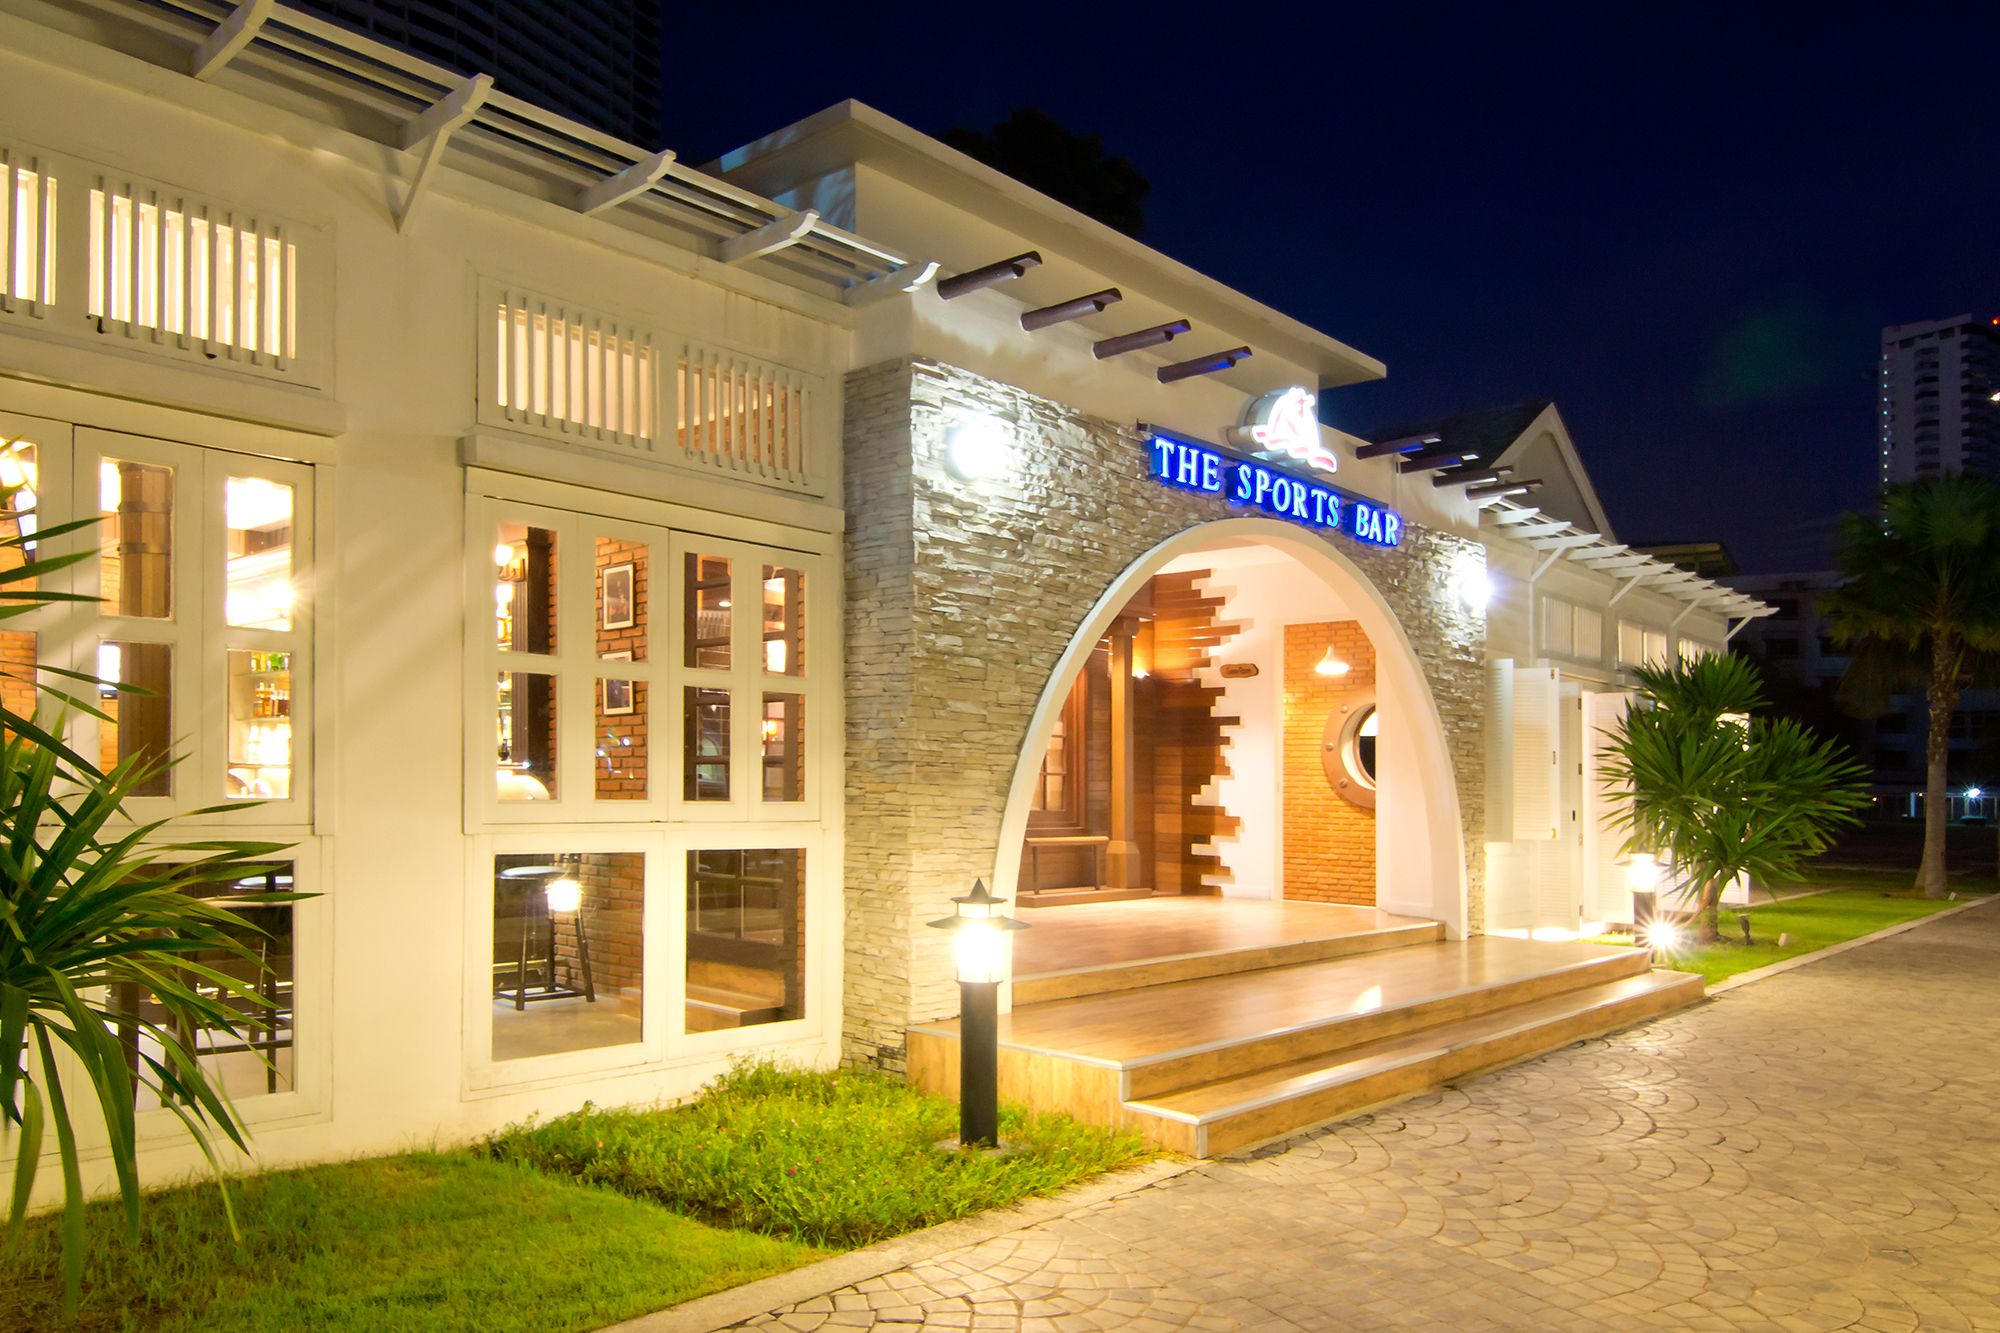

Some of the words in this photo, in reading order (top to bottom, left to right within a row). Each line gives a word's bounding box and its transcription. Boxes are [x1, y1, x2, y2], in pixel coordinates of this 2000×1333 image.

[1155, 437, 1221, 492] THE
[1236, 464, 1340, 528] SPORTS
[1355, 504, 1399, 546] BAR
